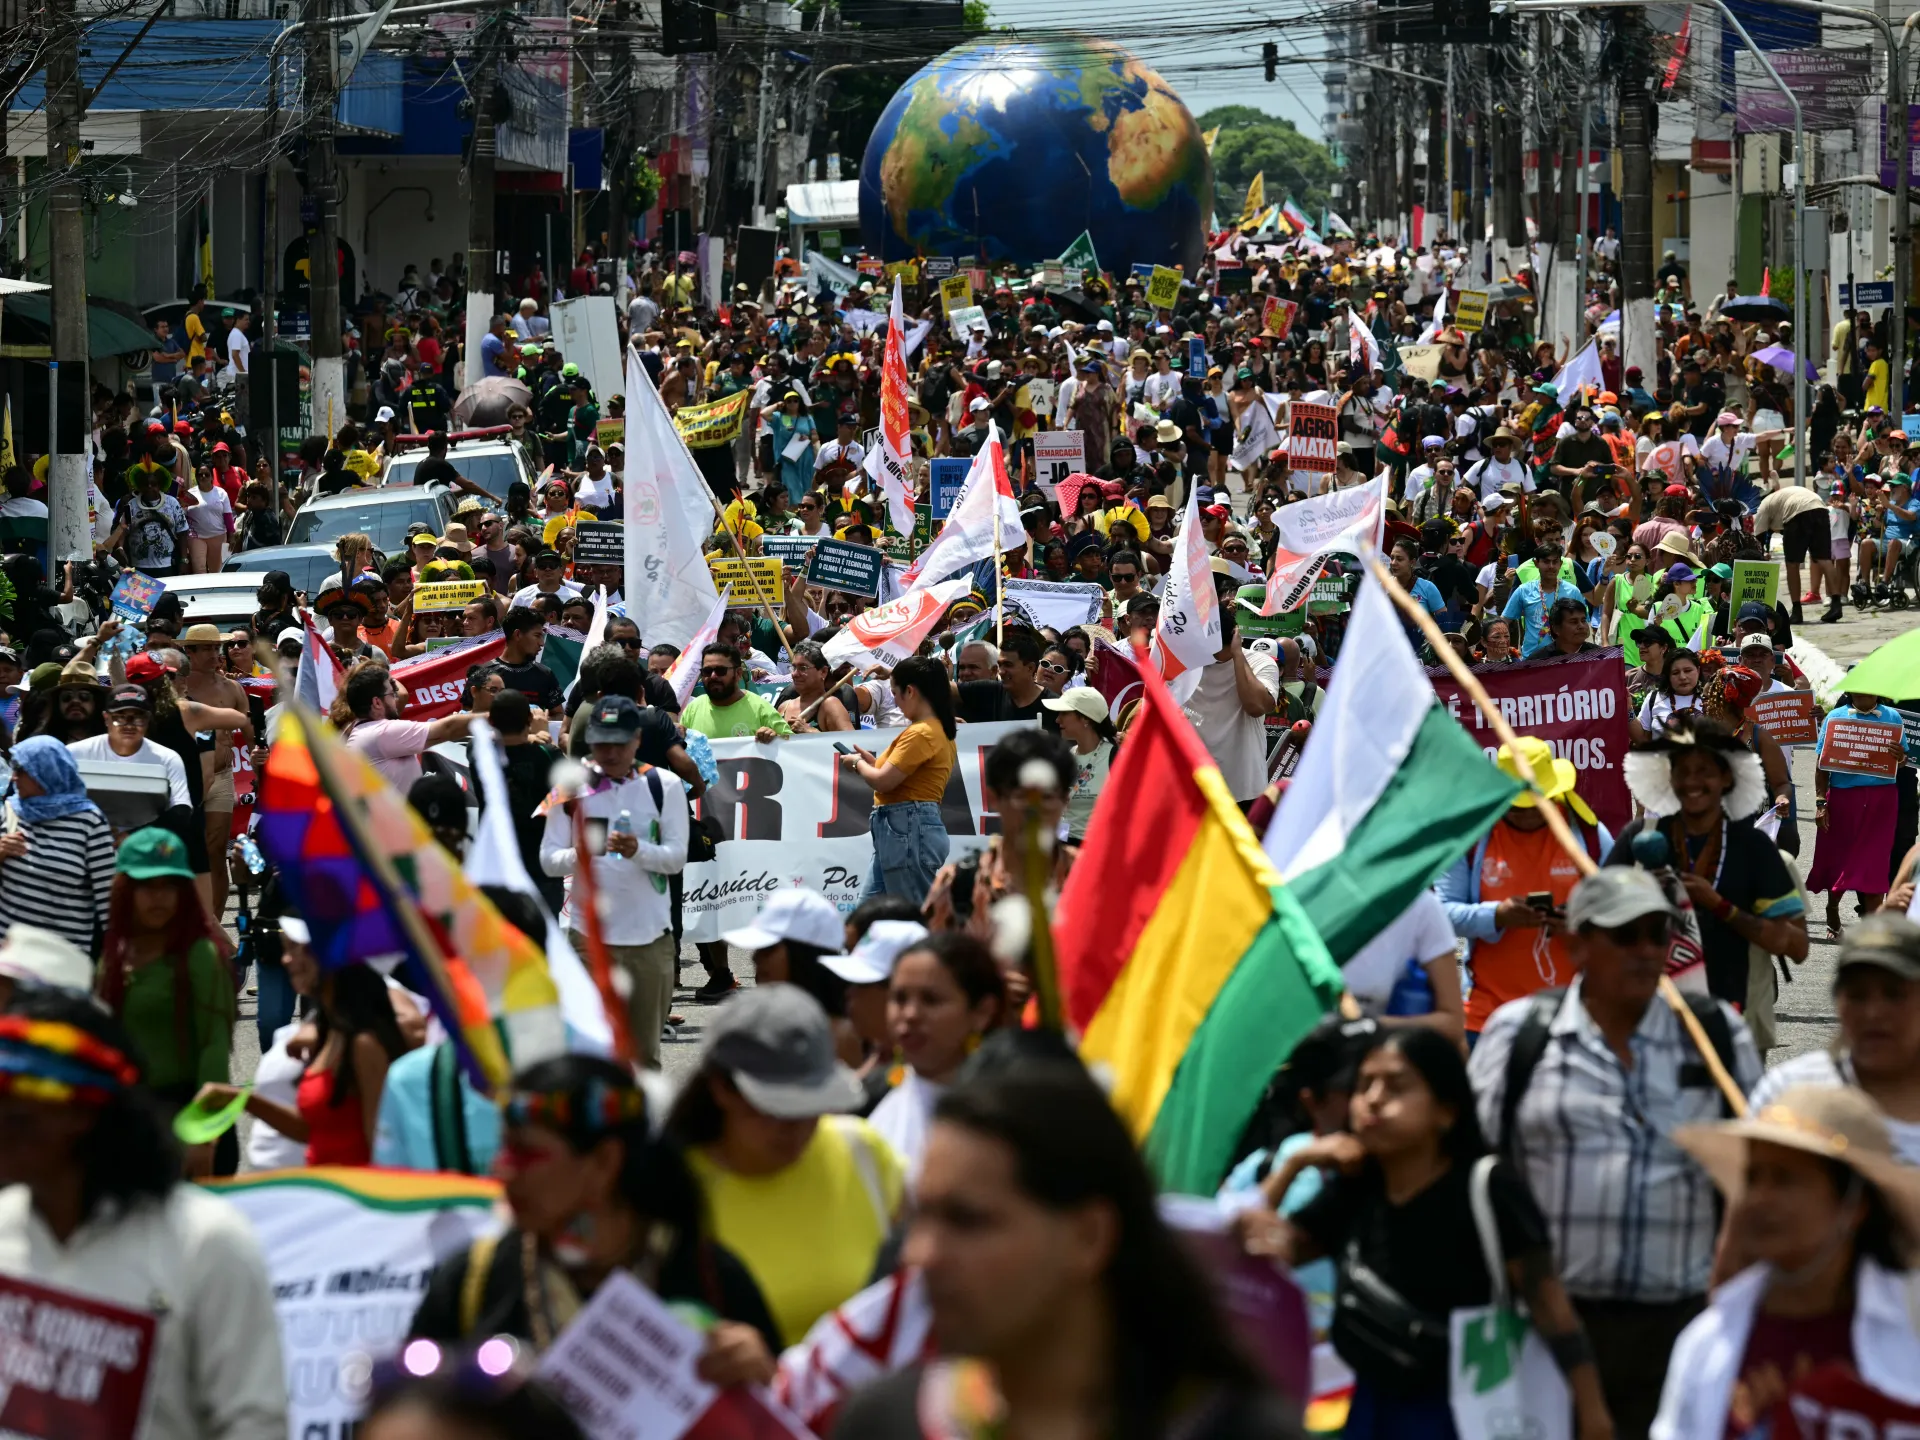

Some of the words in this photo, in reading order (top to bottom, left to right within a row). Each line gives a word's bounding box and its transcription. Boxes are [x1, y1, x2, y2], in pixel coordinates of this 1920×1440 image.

[1797, 62, 1846, 73] BRILHANTE
[599, 430, 624, 439] poder
[1292, 416, 1336, 441] AGRO
[1036, 448, 1082, 458] DEMARCAÇÃO
[1291, 436, 1336, 460] MATA
[940, 465, 963, 473] FLORESTA
[940, 474, 954, 486] EM
[940, 497, 950, 510] DE
[823, 546, 849, 559] TERRITÓRIO
[887, 547, 922, 558] CLIMÁTCA
[739, 562, 765, 570] TEITÓRIO
[818, 554, 841, 566] FLORESTA
[823, 564, 838, 573] CLIMA
[1743, 570, 1752, 578] SEM
[1752, 570, 1770, 579] JUSTIÇA
[440, 584, 459, 593] ESCOLA,
[459, 583, 469, 591] NÃO
[469, 582, 477, 590] HÁ
[738, 588, 748, 596] NÃO
[748, 587, 755, 595] HÁ
[1281, 575, 1310, 611] direitos
[1741, 586, 1755, 599] NÃO
[1756, 586, 1766, 599] HÁ
[422, 593, 438, 602] CLIMA,
[440, 592, 449, 600] NÃO
[450, 590, 457, 599] HÁ
[457, 590, 477, 599] FUTURO.
[112, 605, 142, 623] ecosurf
[1022, 602, 1042, 630] INDÍGEN
[1172, 611, 1188, 637] Pa
[1751, 634, 1762, 644] NY
[416, 679, 471, 706] DEST
[1755, 703, 1773, 712] MARCO
[1773, 698, 1803, 709] TEMPORAL
[1758, 711, 1779, 721] DESTRÓI
[1780, 710, 1800, 719] POVOS,
[1792, 719, 1811, 728] CLIMA.
[1834, 724, 1858, 736] EDUCAÇÃO
[1868, 728, 1883, 736] NASCE
[1832, 740, 1849, 748] FUTURO
[1833, 732, 1861, 743] TERRITÓRIOS
[1865, 735, 1886, 745] POLÍTICA
[1544, 738, 1614, 770] VOS.
[681, 896, 738, 914] Trabalhadores
[738, 893, 755, 903] em
